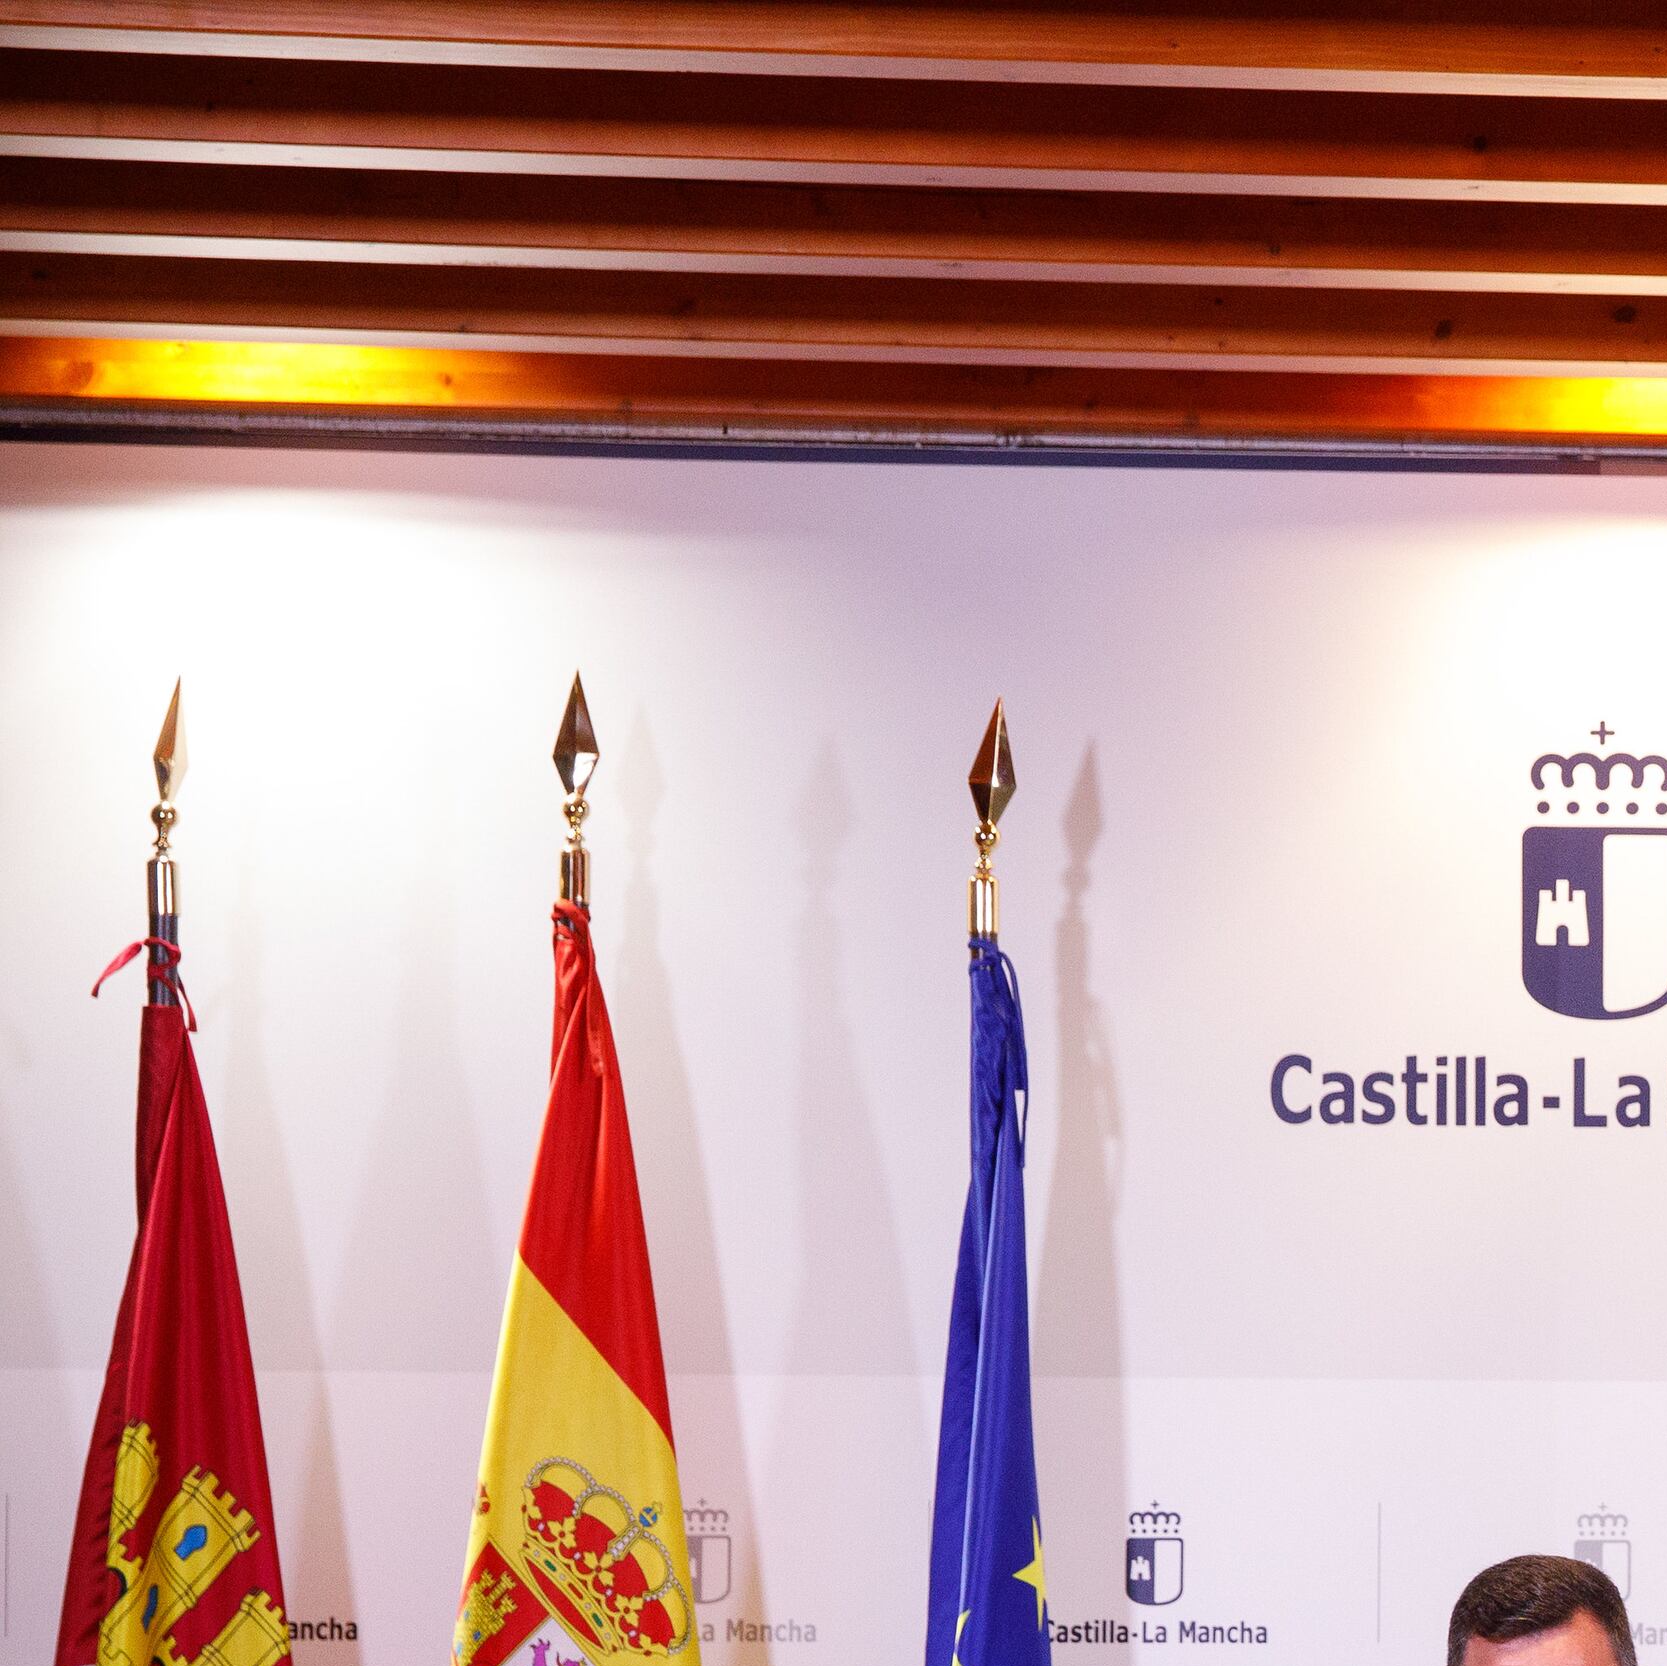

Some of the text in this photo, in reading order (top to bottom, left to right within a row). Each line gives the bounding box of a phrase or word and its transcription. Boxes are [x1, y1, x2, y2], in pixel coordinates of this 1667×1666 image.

[1270, 1054, 1650, 1128] Castilla-La
[288, 1618, 358, 1641] ancha
[725, 1618, 817, 1643] Mancha
[1047, 1620, 1268, 1644] Castilla-La Mancha
